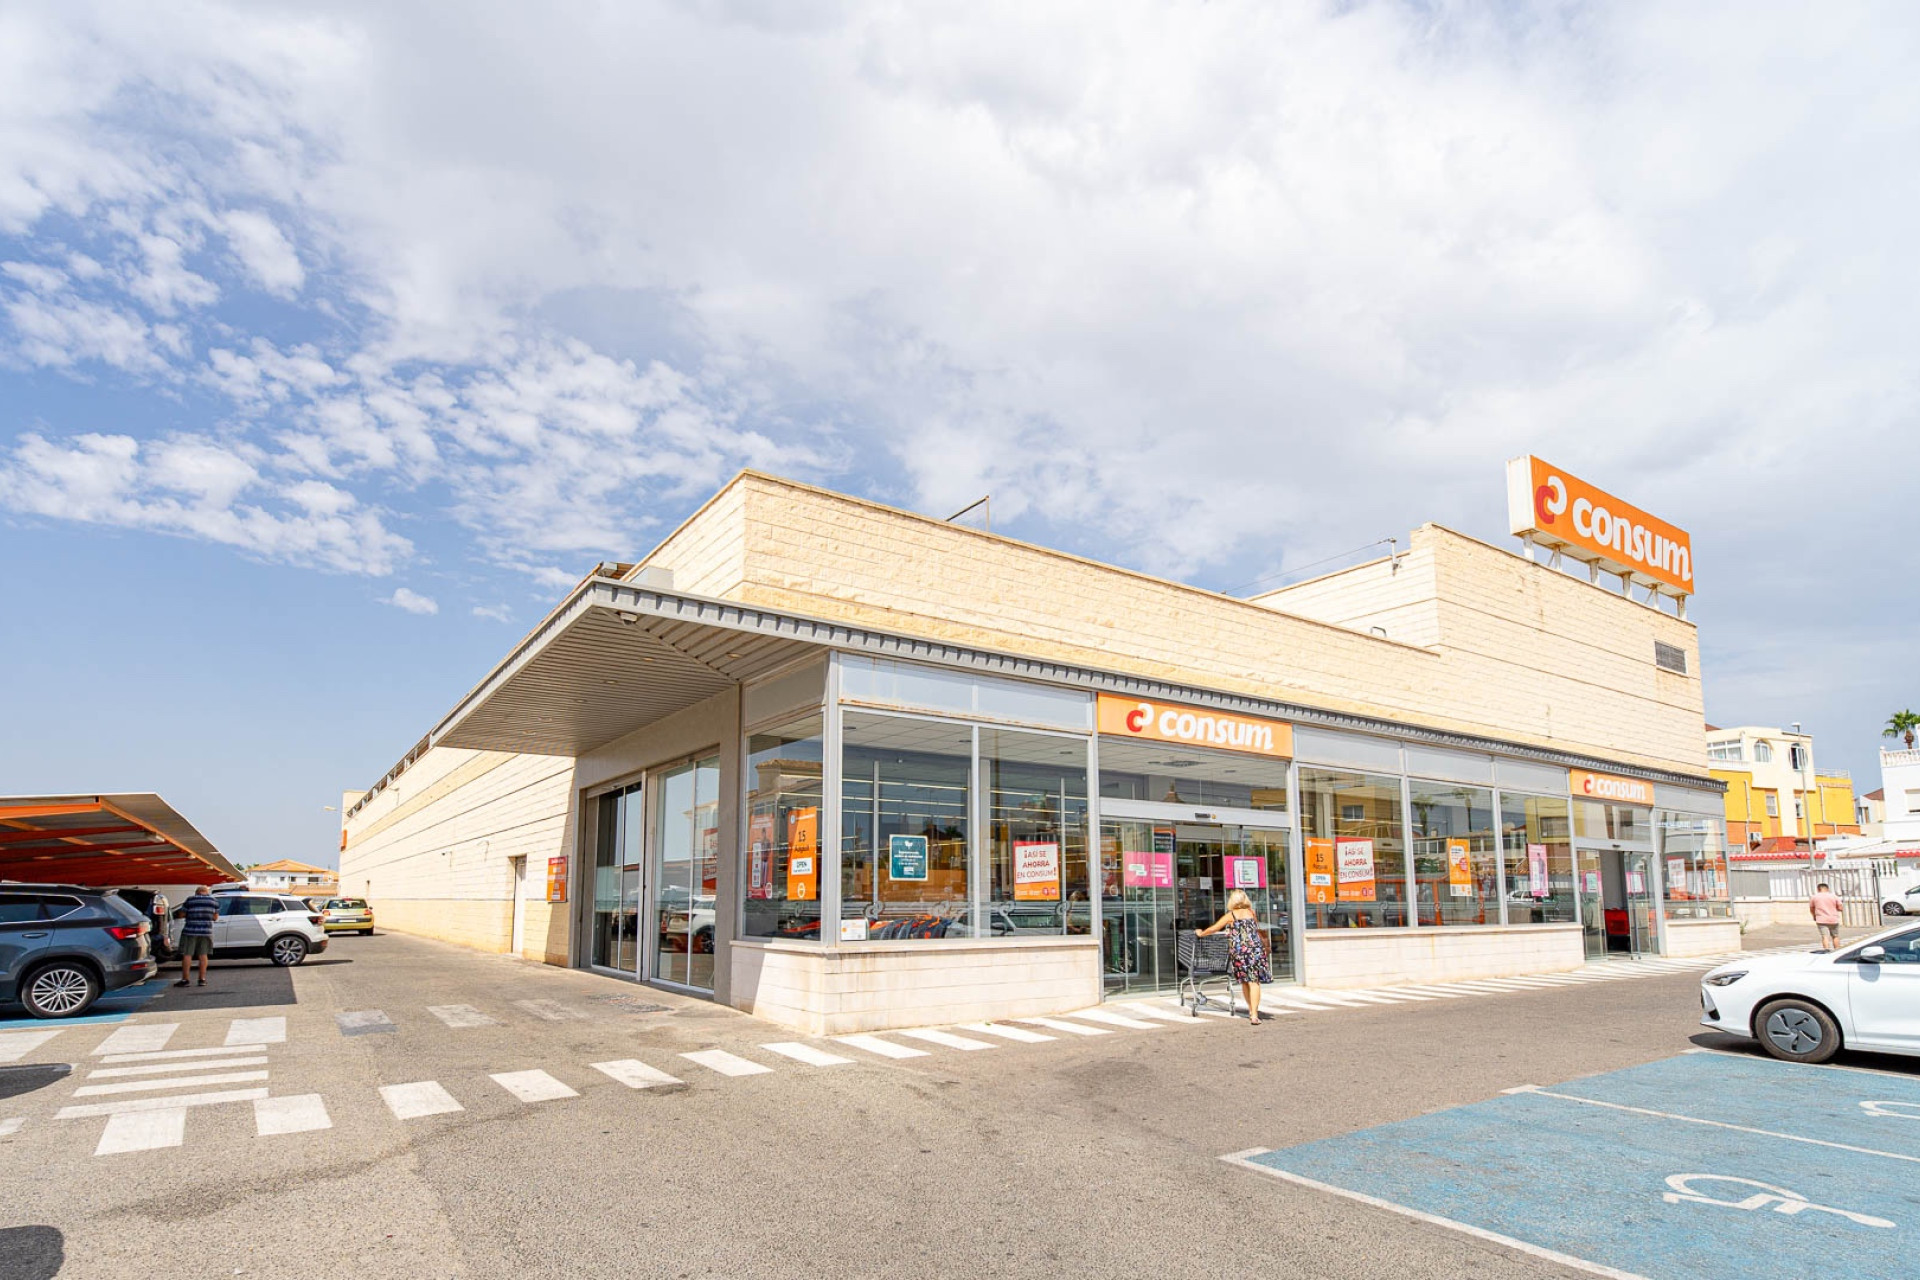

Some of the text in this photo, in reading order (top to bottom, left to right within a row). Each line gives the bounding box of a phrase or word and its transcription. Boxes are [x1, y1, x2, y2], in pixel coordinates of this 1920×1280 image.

[1572, 497, 1692, 582] consum
[1158, 710, 1274, 751] consum
[1596, 778, 1646, 800] consum
[1022, 860, 1050, 869] AHORRA
[1344, 858, 1367, 866] AHORRA
[1017, 871, 1026, 879] EN
